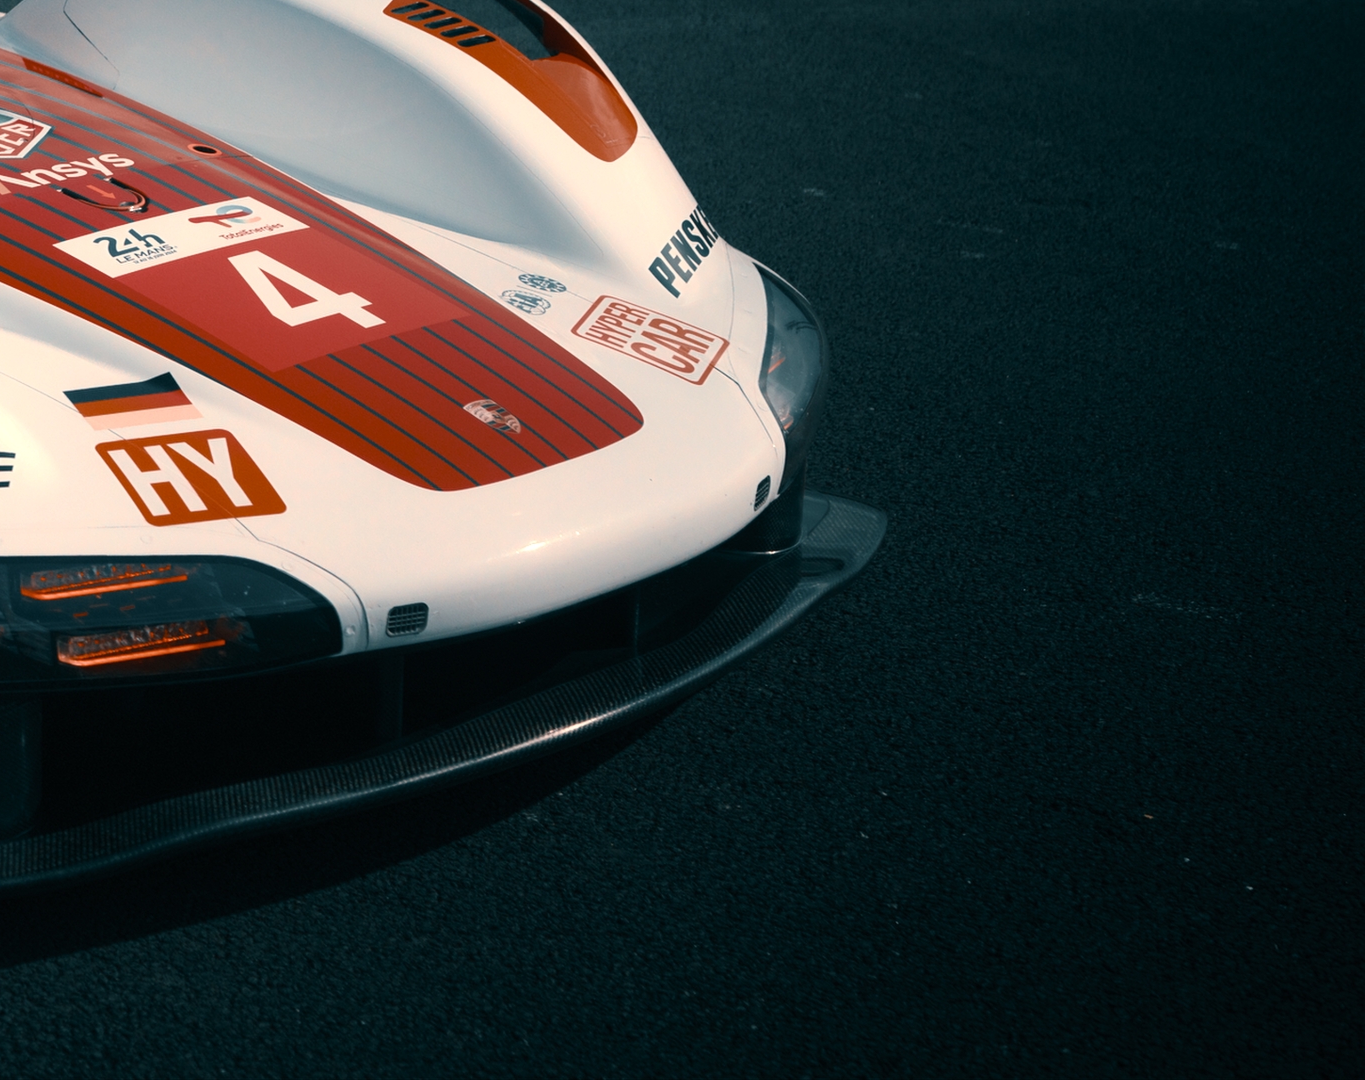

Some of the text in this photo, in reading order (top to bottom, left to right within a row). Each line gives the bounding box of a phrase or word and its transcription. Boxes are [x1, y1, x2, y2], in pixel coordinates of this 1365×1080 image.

[93, 228, 166, 257] 24h
[115, 253, 137, 265] LE
[134, 244, 174, 259] MANS
[219, 223, 285, 240] TotalEnergies
[227, 250, 387, 329] 4
[584, 301, 651, 349] HYPER
[630, 317, 716, 375] CAR
[106, 435, 254, 518] HY
